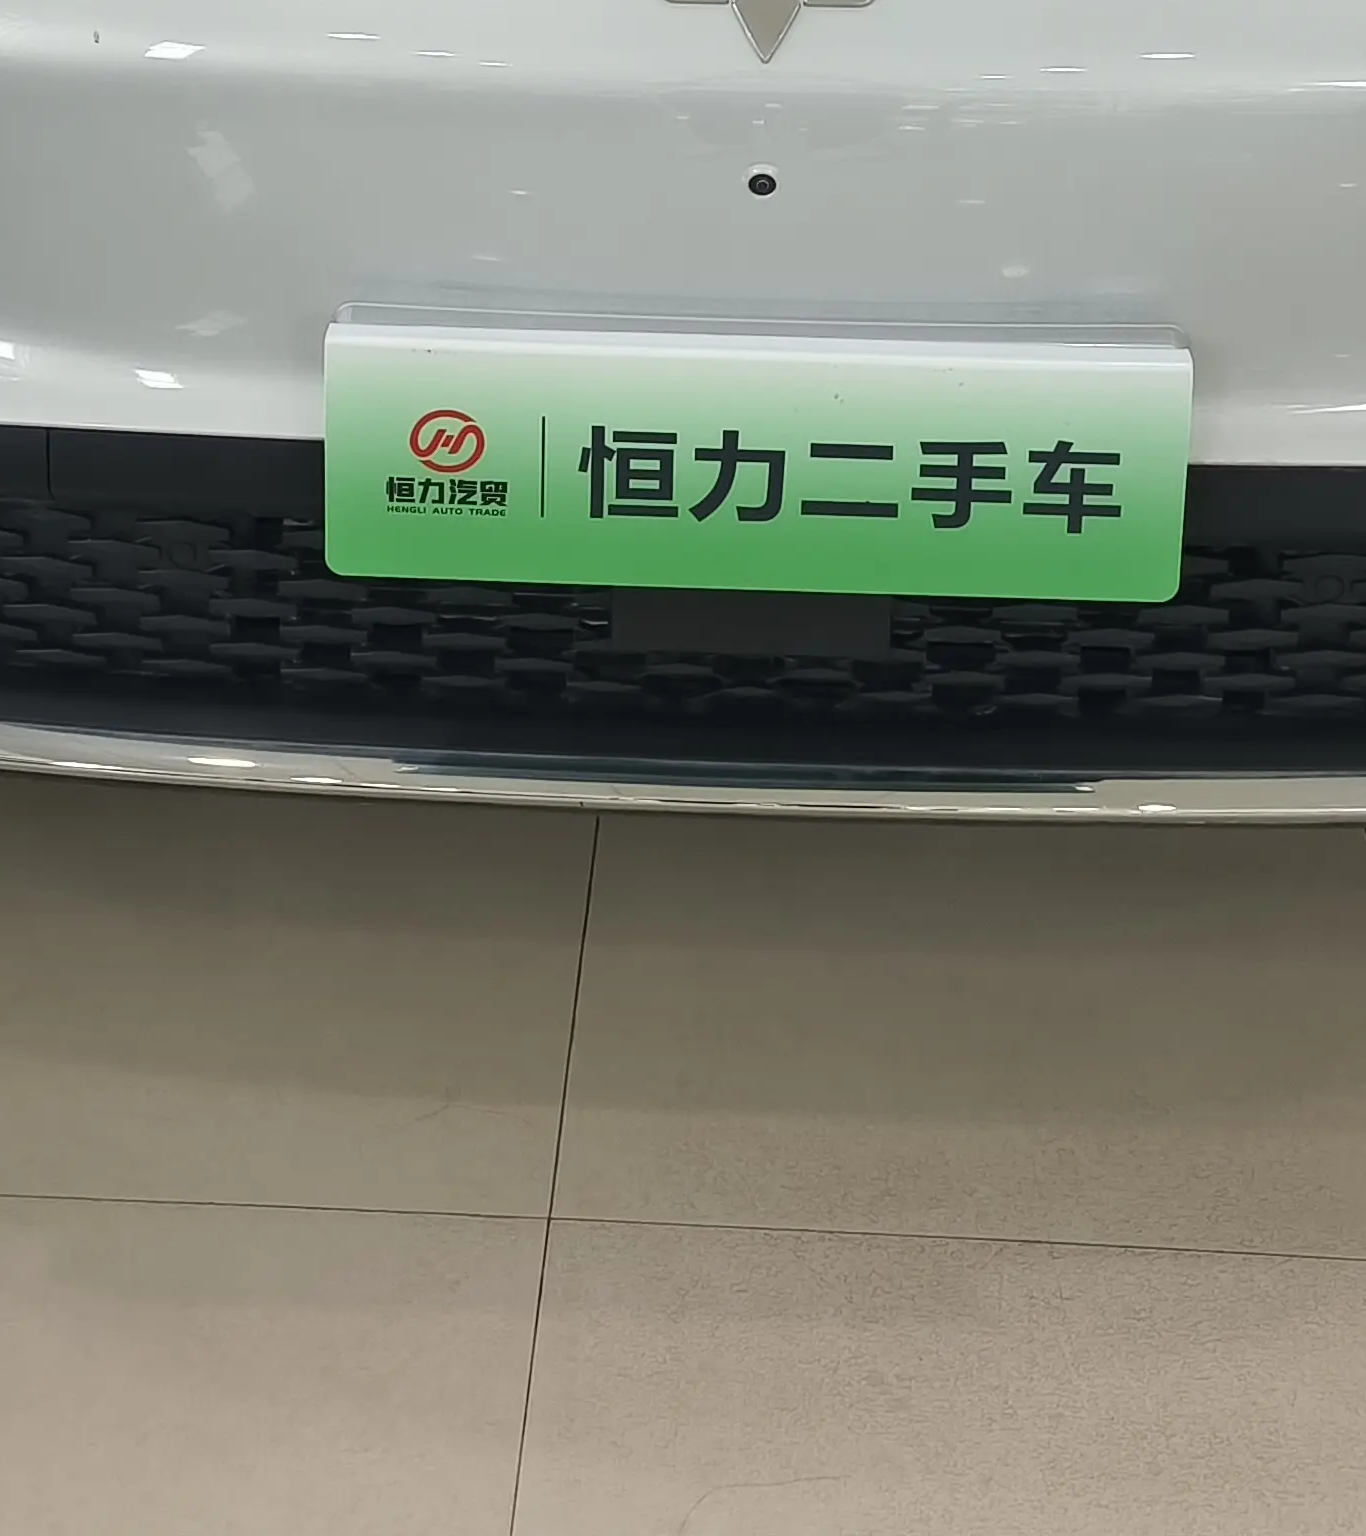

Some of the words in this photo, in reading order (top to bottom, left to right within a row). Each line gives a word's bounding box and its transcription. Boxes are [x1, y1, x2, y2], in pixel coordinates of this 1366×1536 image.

[386, 476, 508, 507] 恒力汽贸
[578, 424, 1125, 534] 恒力二手车
[387, 505, 426, 514] HENGLI
[432, 507, 463, 515] AUTO
[469, 508, 506, 517] TRADE
